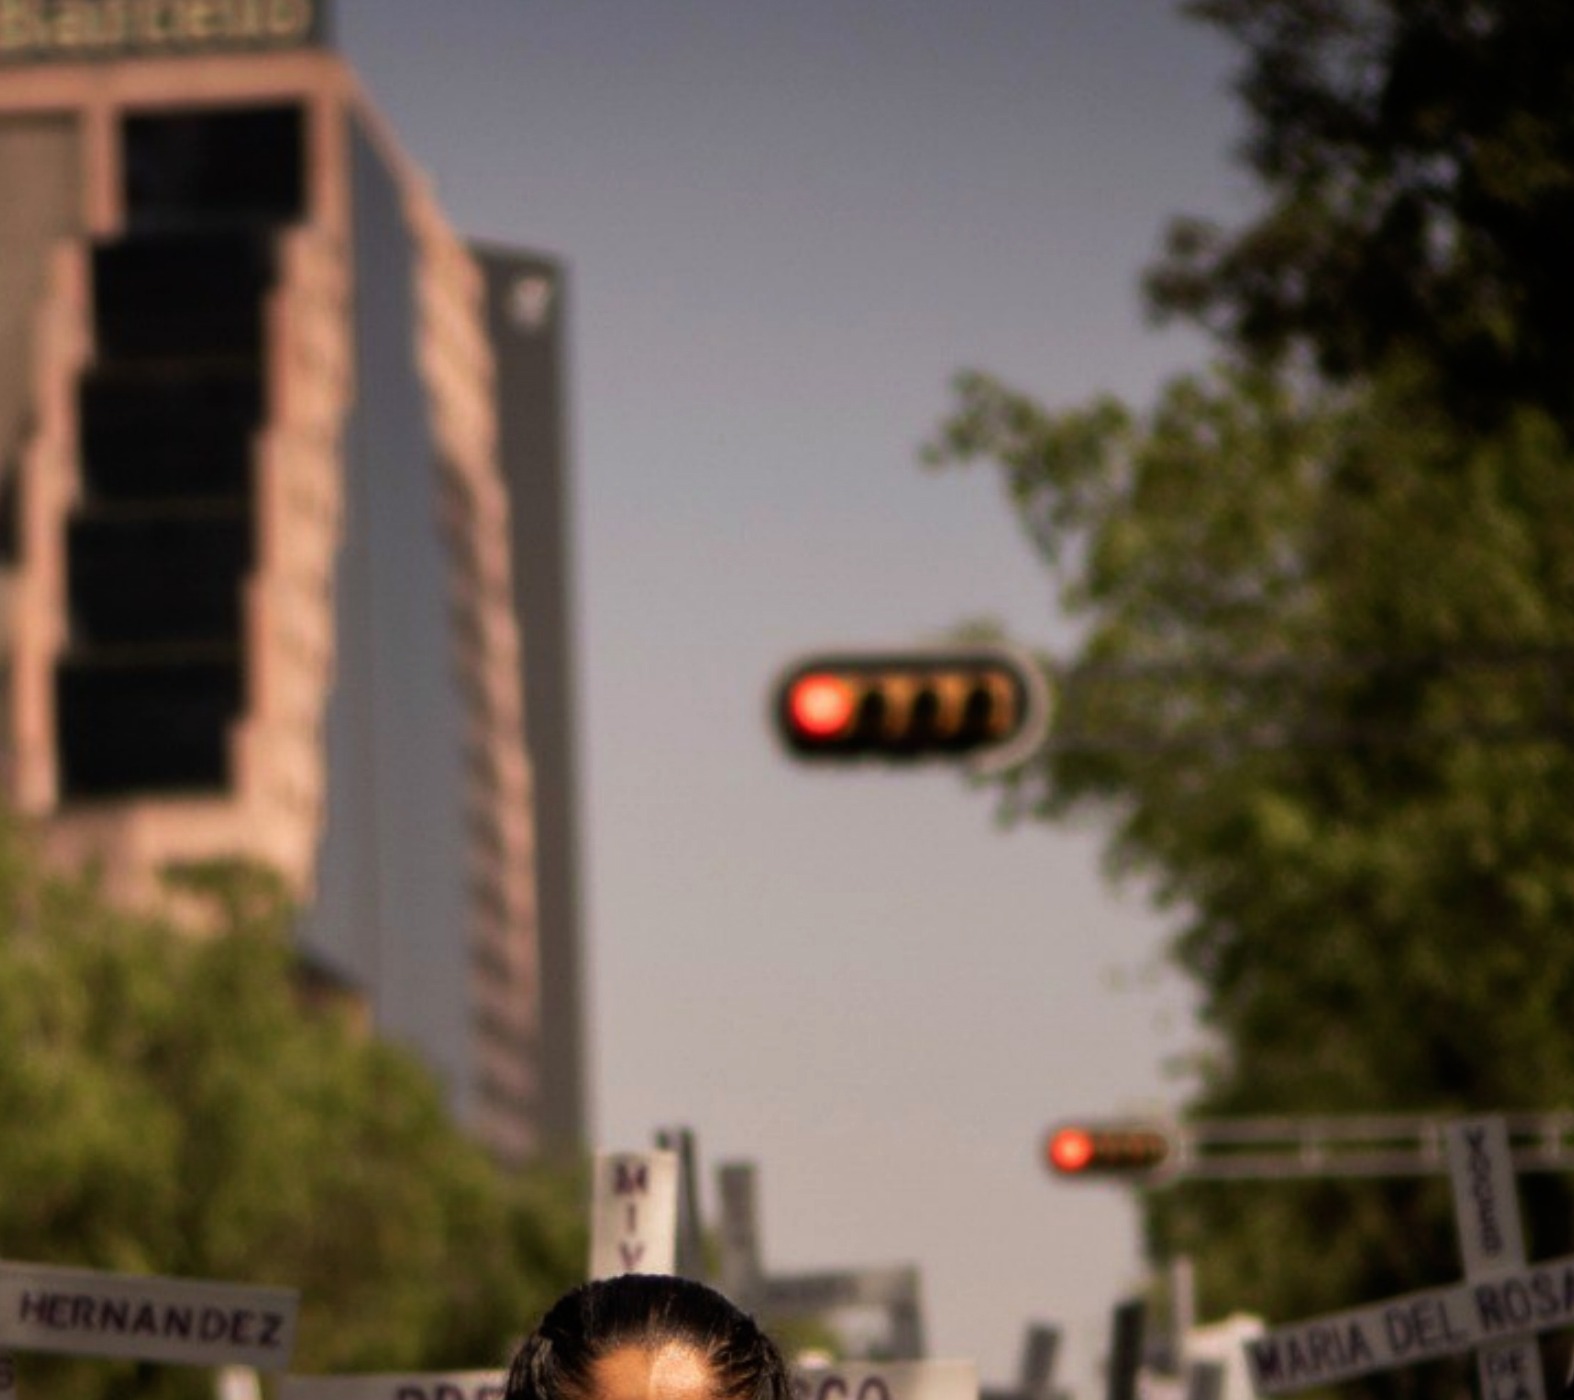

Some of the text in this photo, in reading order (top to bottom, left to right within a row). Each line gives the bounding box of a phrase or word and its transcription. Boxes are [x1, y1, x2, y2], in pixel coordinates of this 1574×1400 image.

[18, 1290, 286, 1347] HERNANDEZ
[1253, 1320, 1375, 1379] MARIA
[1385, 1299, 1467, 1354] DEL
